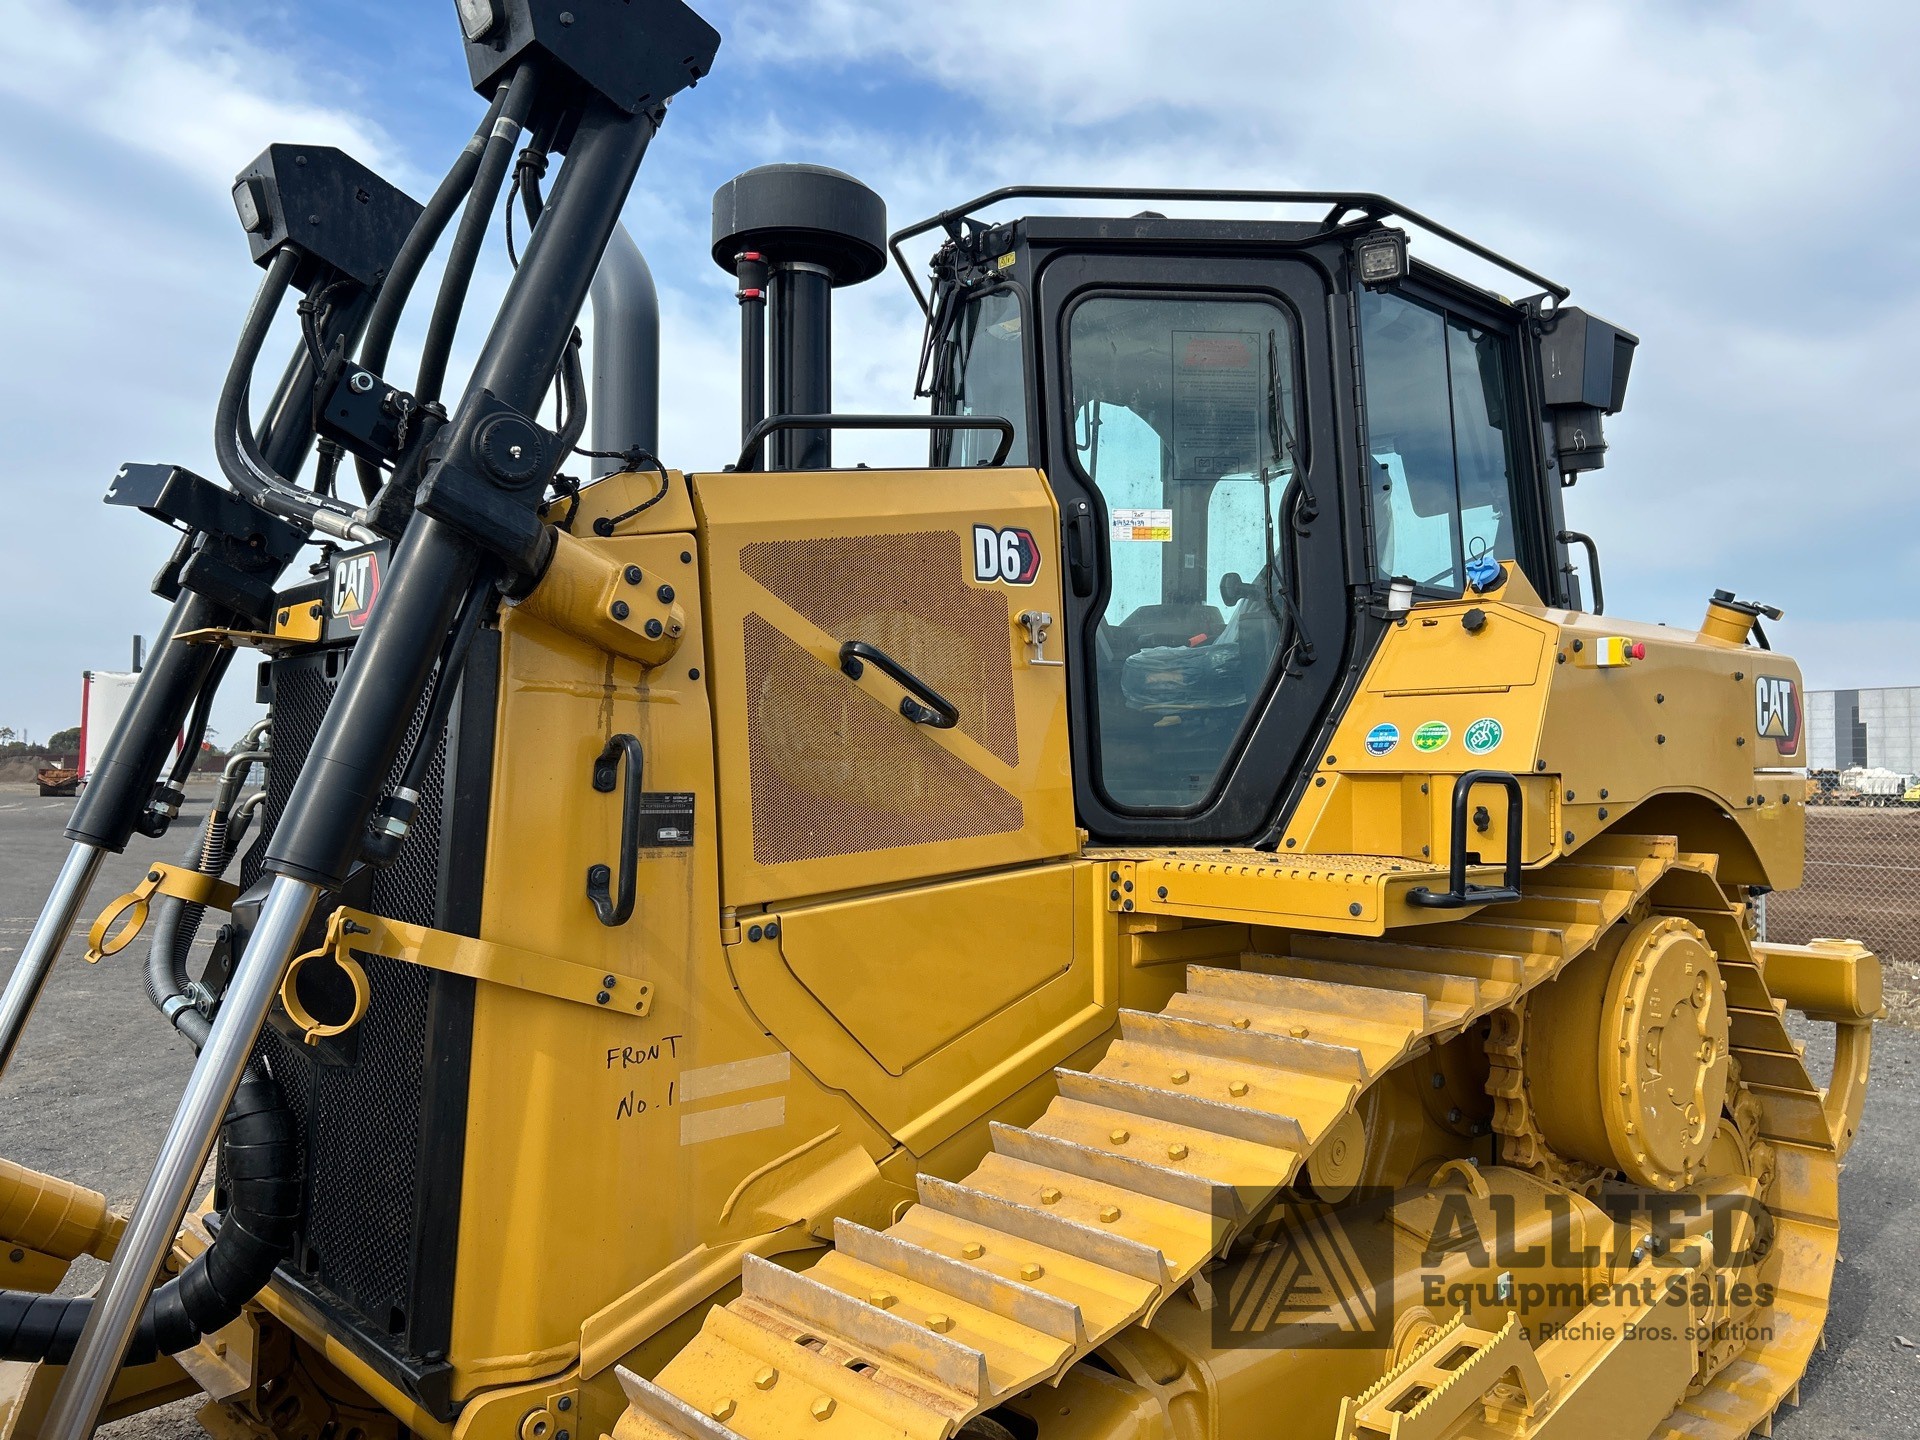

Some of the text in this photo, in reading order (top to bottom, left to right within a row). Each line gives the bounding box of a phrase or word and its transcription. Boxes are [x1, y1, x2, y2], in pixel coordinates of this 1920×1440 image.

[975, 527, 1021, 580] D6
[333, 556, 370, 614] CAT
[1756, 677, 1791, 737] CAT
[607, 1035, 683, 1070] FRONT
